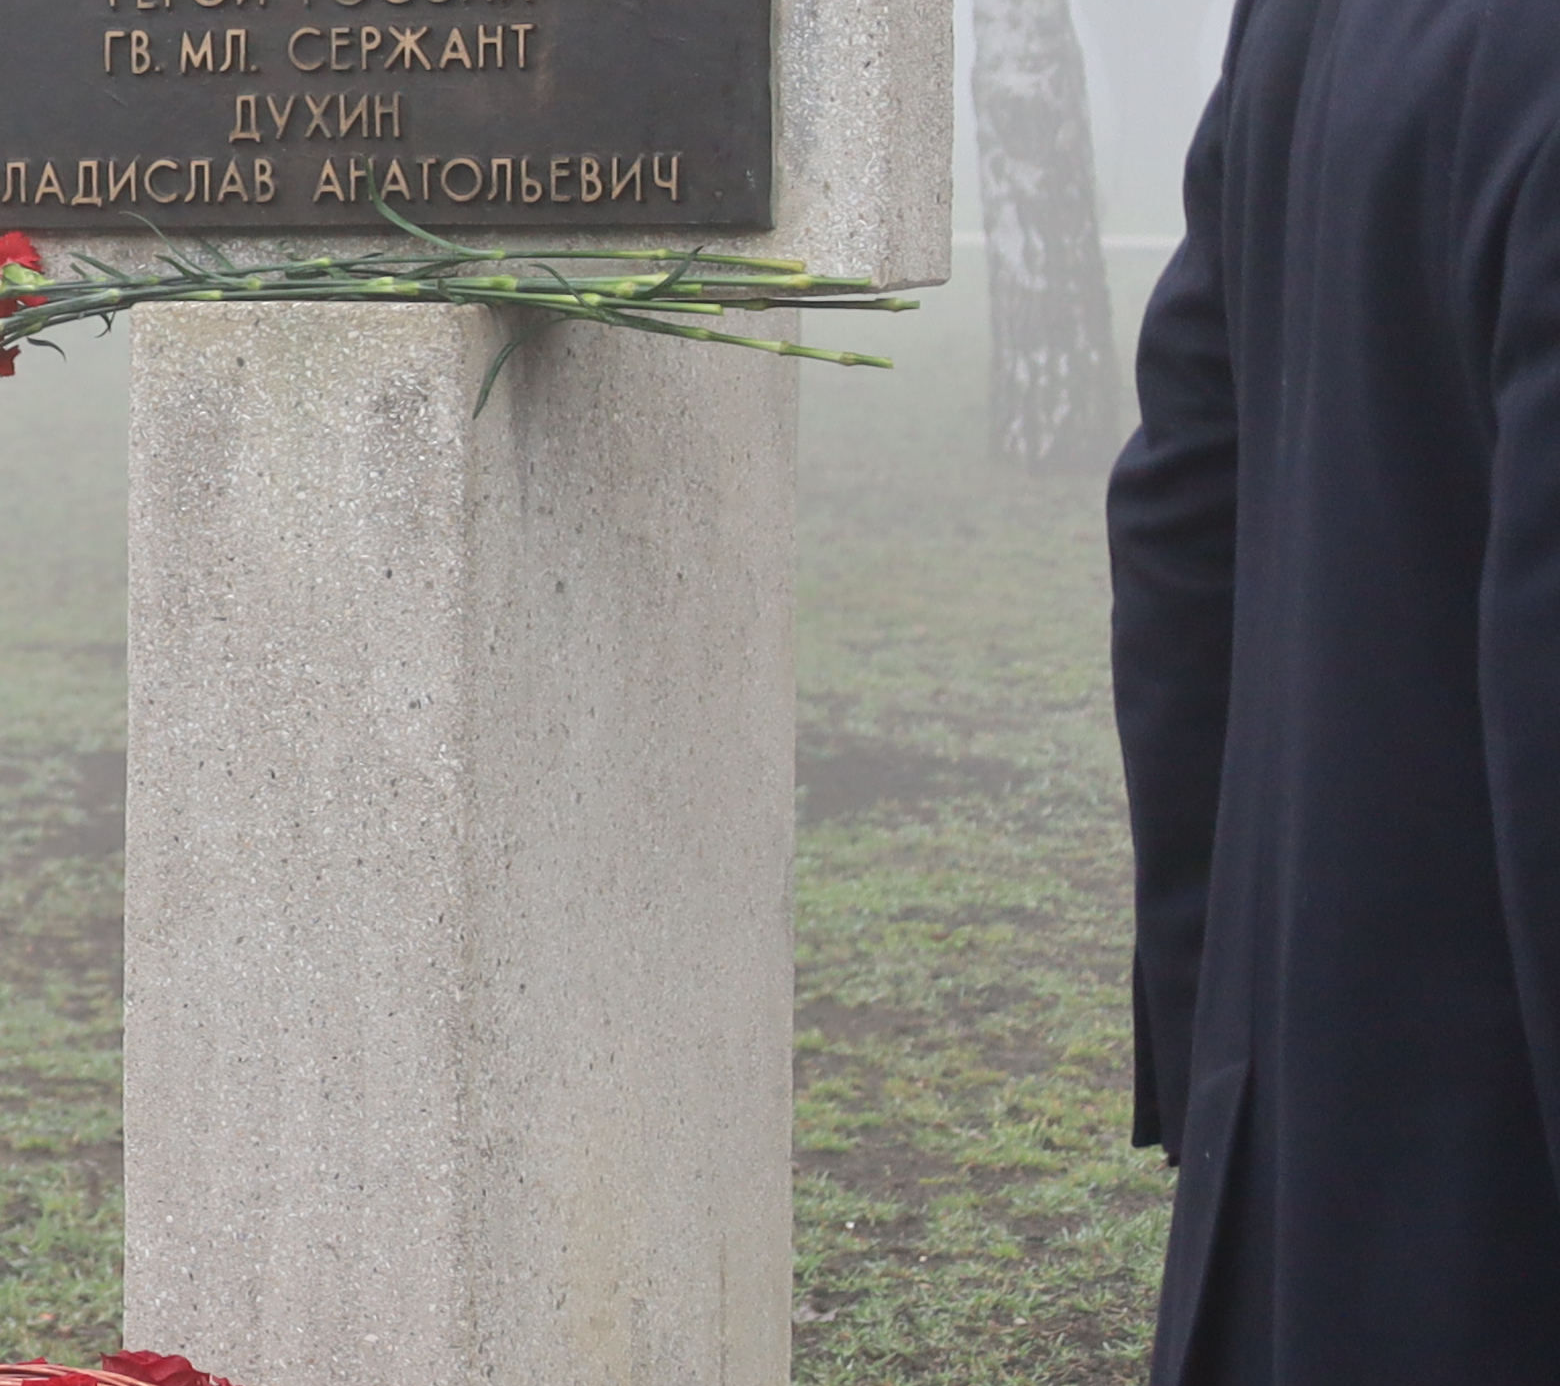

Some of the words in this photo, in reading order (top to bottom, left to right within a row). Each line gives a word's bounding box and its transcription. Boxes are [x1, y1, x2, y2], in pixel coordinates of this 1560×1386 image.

[103, 30, 163, 75] ГВ.
[179, 28, 258, 74] МЛ.
[289, 24, 533, 71] СЕРЖАНТ
[228, 92, 400, 143] ДУХИН
[313, 152, 681, 203] АНАТОЛЬЕВИЧ
